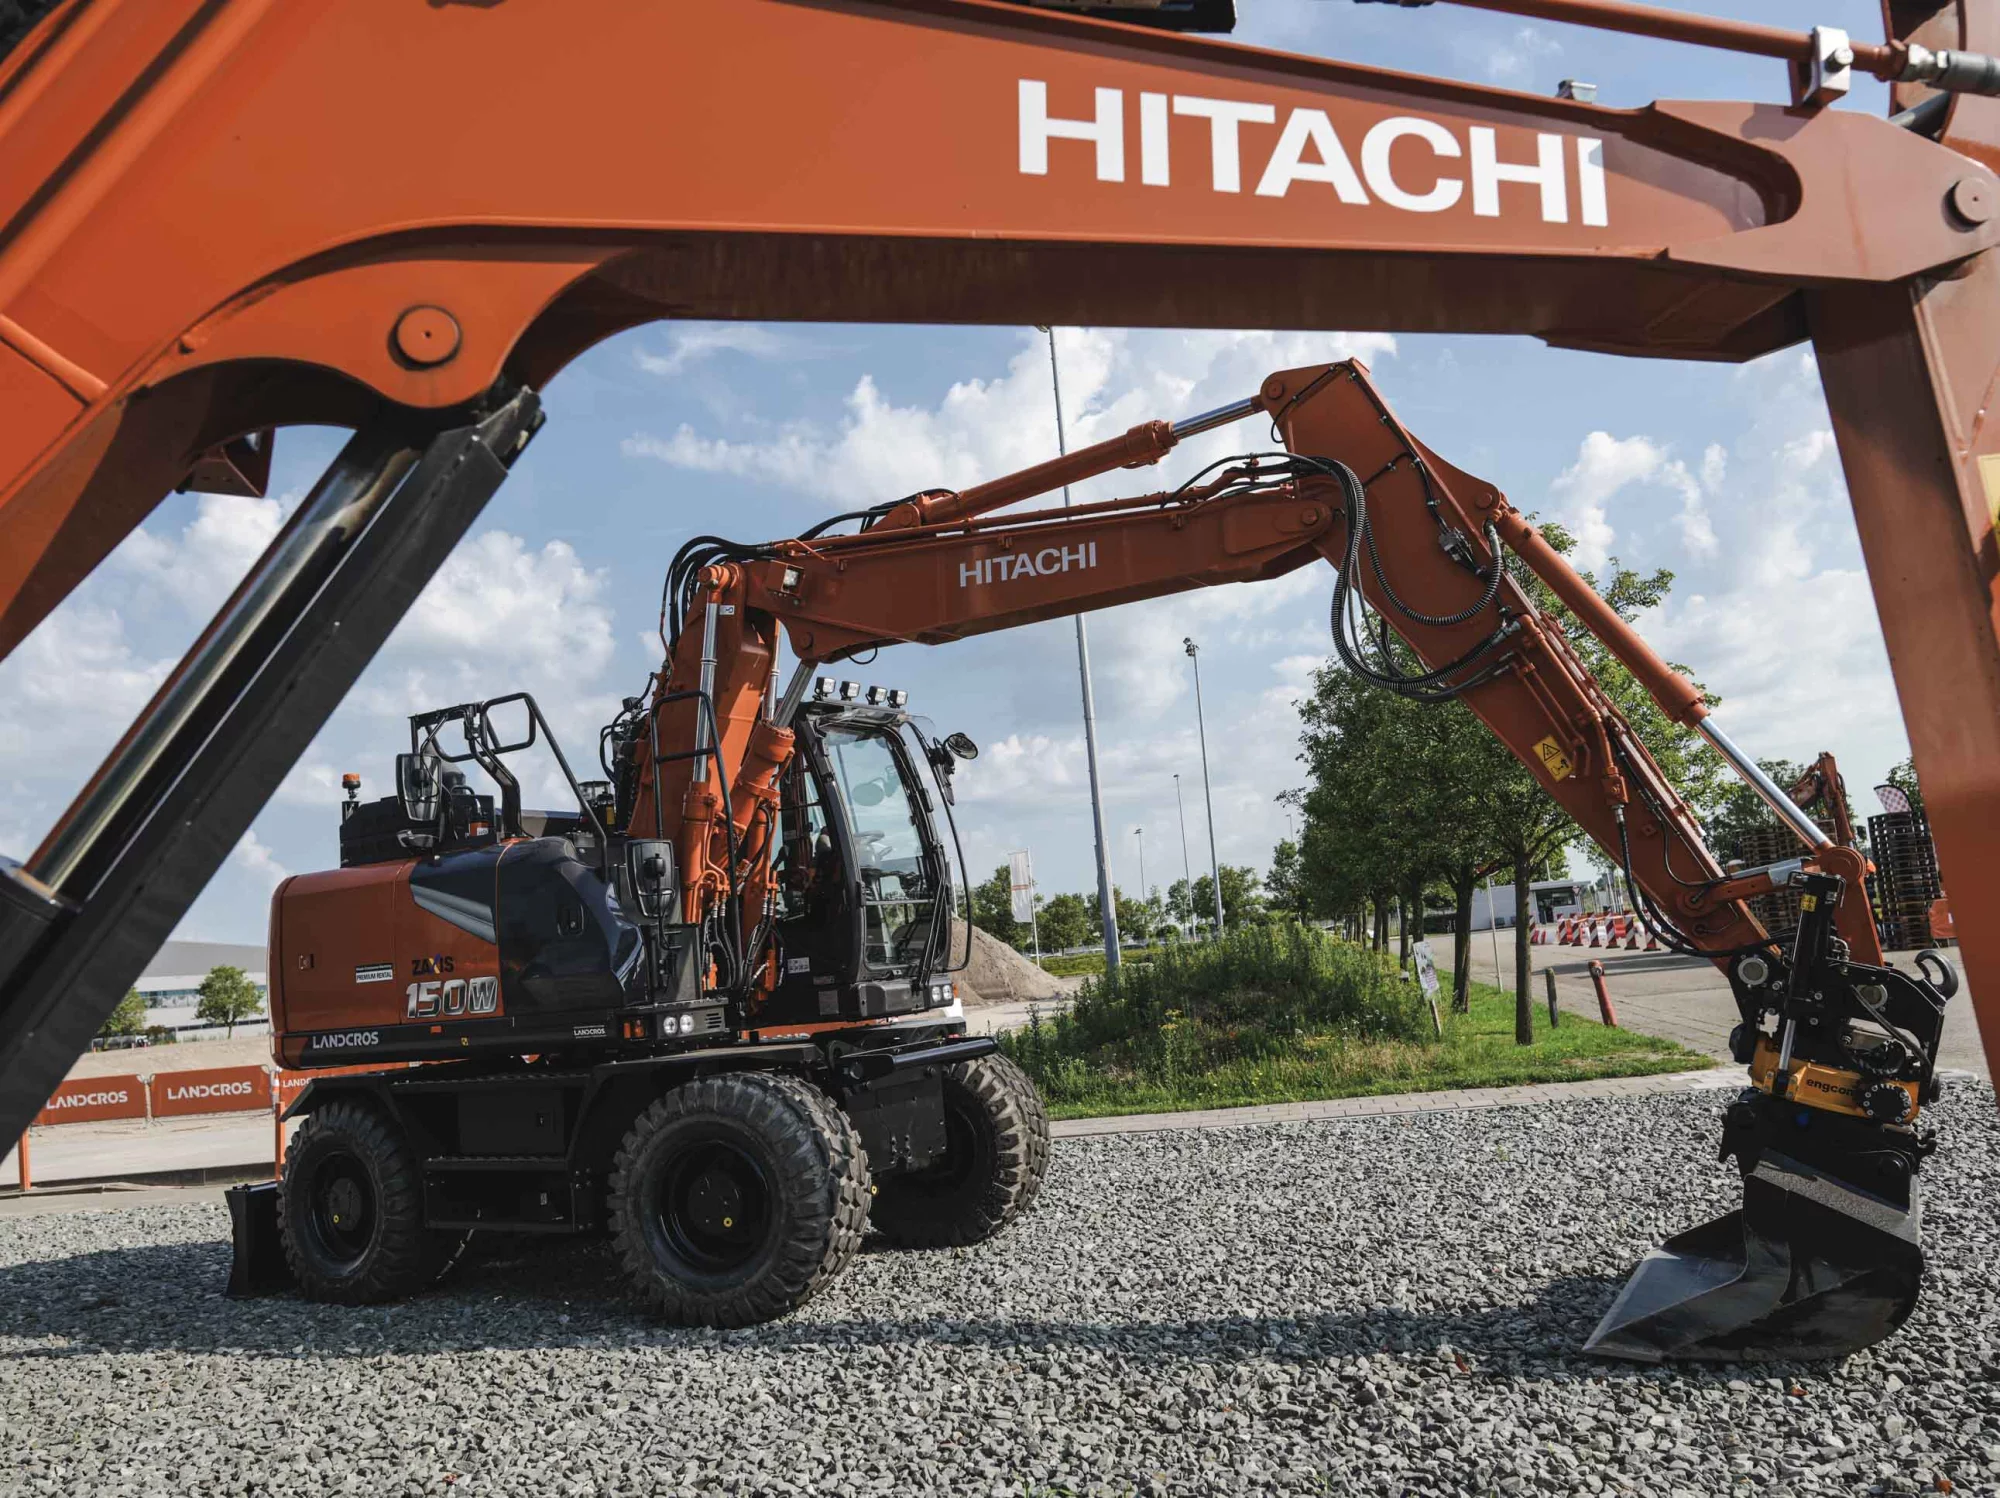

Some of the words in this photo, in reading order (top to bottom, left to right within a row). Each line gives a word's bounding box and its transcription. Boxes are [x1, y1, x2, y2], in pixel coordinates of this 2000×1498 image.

[1018, 78, 1608, 227] HITACHI
[959, 541, 1097, 588] HITACHI
[411, 953, 454, 976] ZAXIS
[357, 972, 376, 981] PREMIUM
[376, 970, 392, 979] RENTAL
[406, 976, 498, 1018] 150W
[312, 1031, 379, 1049] LANDCROS
[573, 1027, 606, 1036] LANDCROS
[167, 1081, 253, 1100] LANDCROS
[1806, 1078, 1853, 1096] engcon
[46, 1090, 128, 1110] LANDCROS
